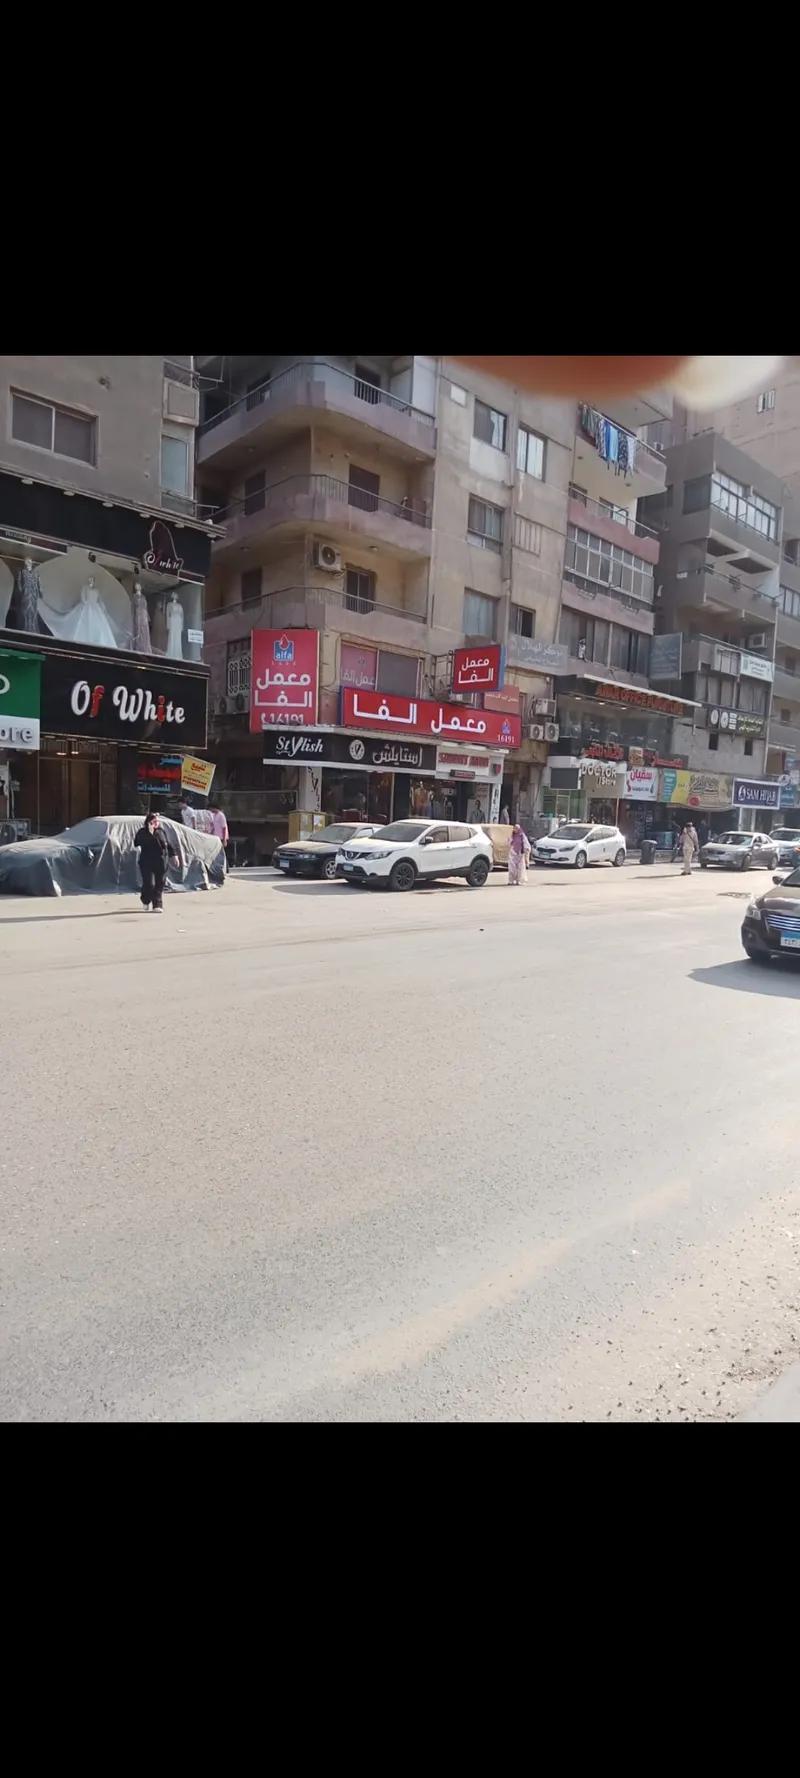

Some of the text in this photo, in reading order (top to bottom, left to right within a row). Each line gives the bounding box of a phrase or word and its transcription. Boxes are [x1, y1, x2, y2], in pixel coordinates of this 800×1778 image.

[274, 651, 292, 660] alfa
[461, 657, 490, 671] معمل
[256, 669, 311, 690] معمل
[458, 668, 494, 684] الفا
[70, 680, 186, 725] Of White
[254, 690, 313, 708] الفا
[353, 693, 487, 734] معمل الفا
[275, 736, 324, 757] Stylish
[497, 734, 516, 745] 16191
[580, 763, 618, 778] DOCTOR
[746, 789, 759, 801] SAM
